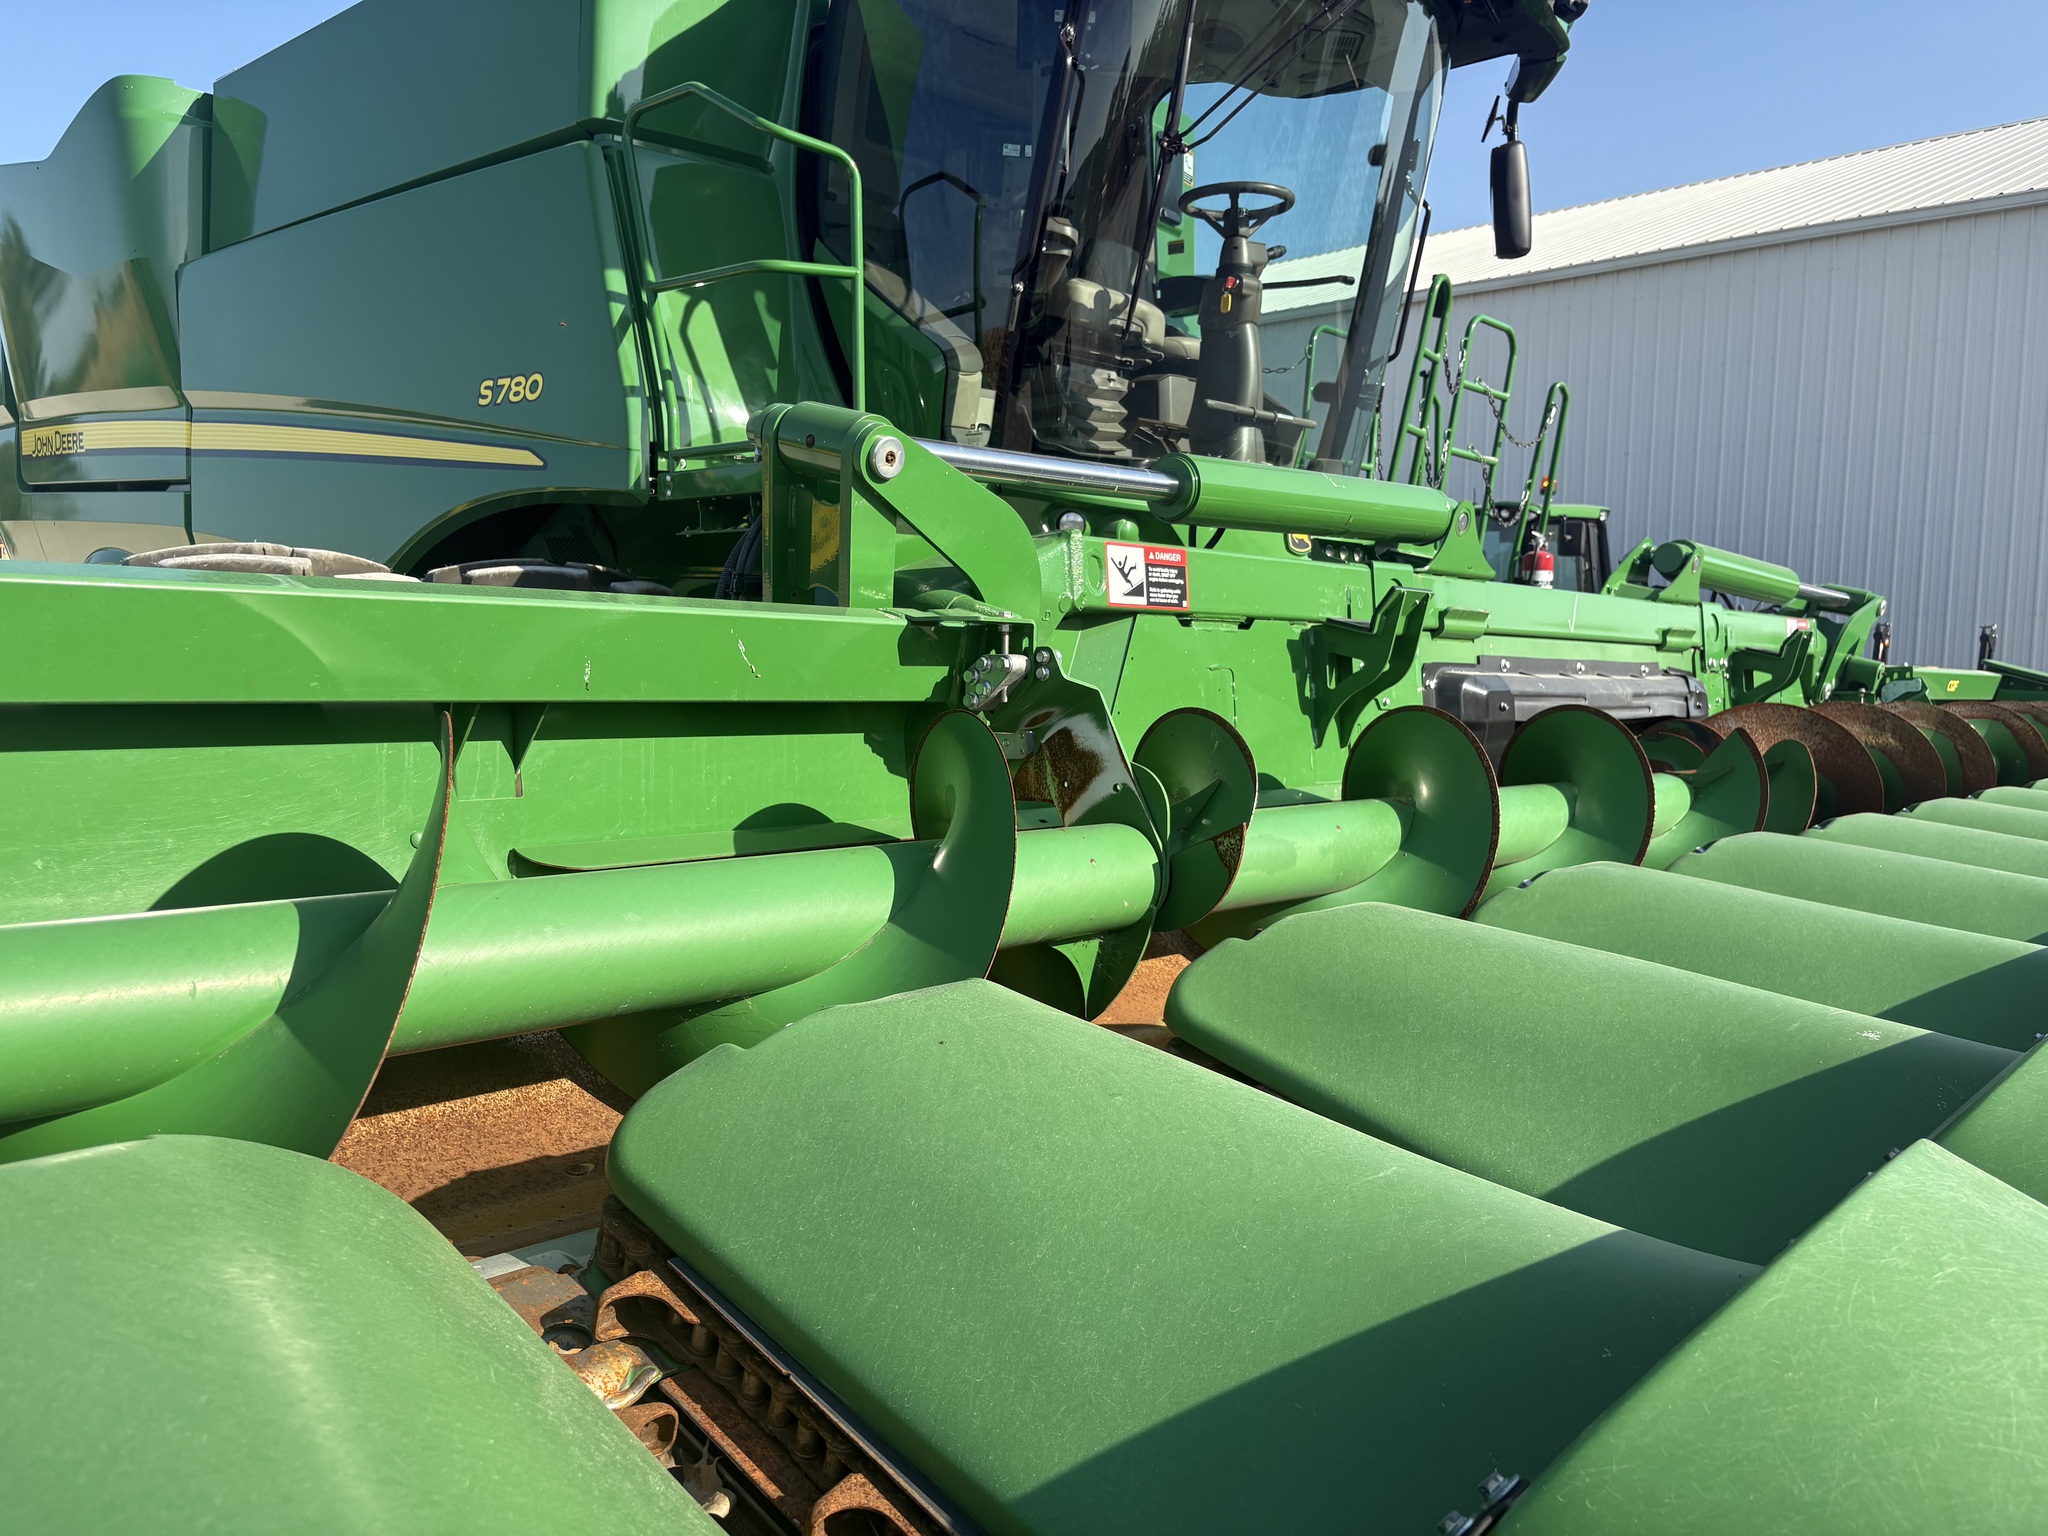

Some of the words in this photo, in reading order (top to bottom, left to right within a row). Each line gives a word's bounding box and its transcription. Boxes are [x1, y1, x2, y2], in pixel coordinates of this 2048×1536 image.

[478, 372, 544, 405] S780
[32, 433, 54, 456] JOHN
[55, 431, 85, 452] DEERE
[1155, 552, 1181, 562] DANGER
